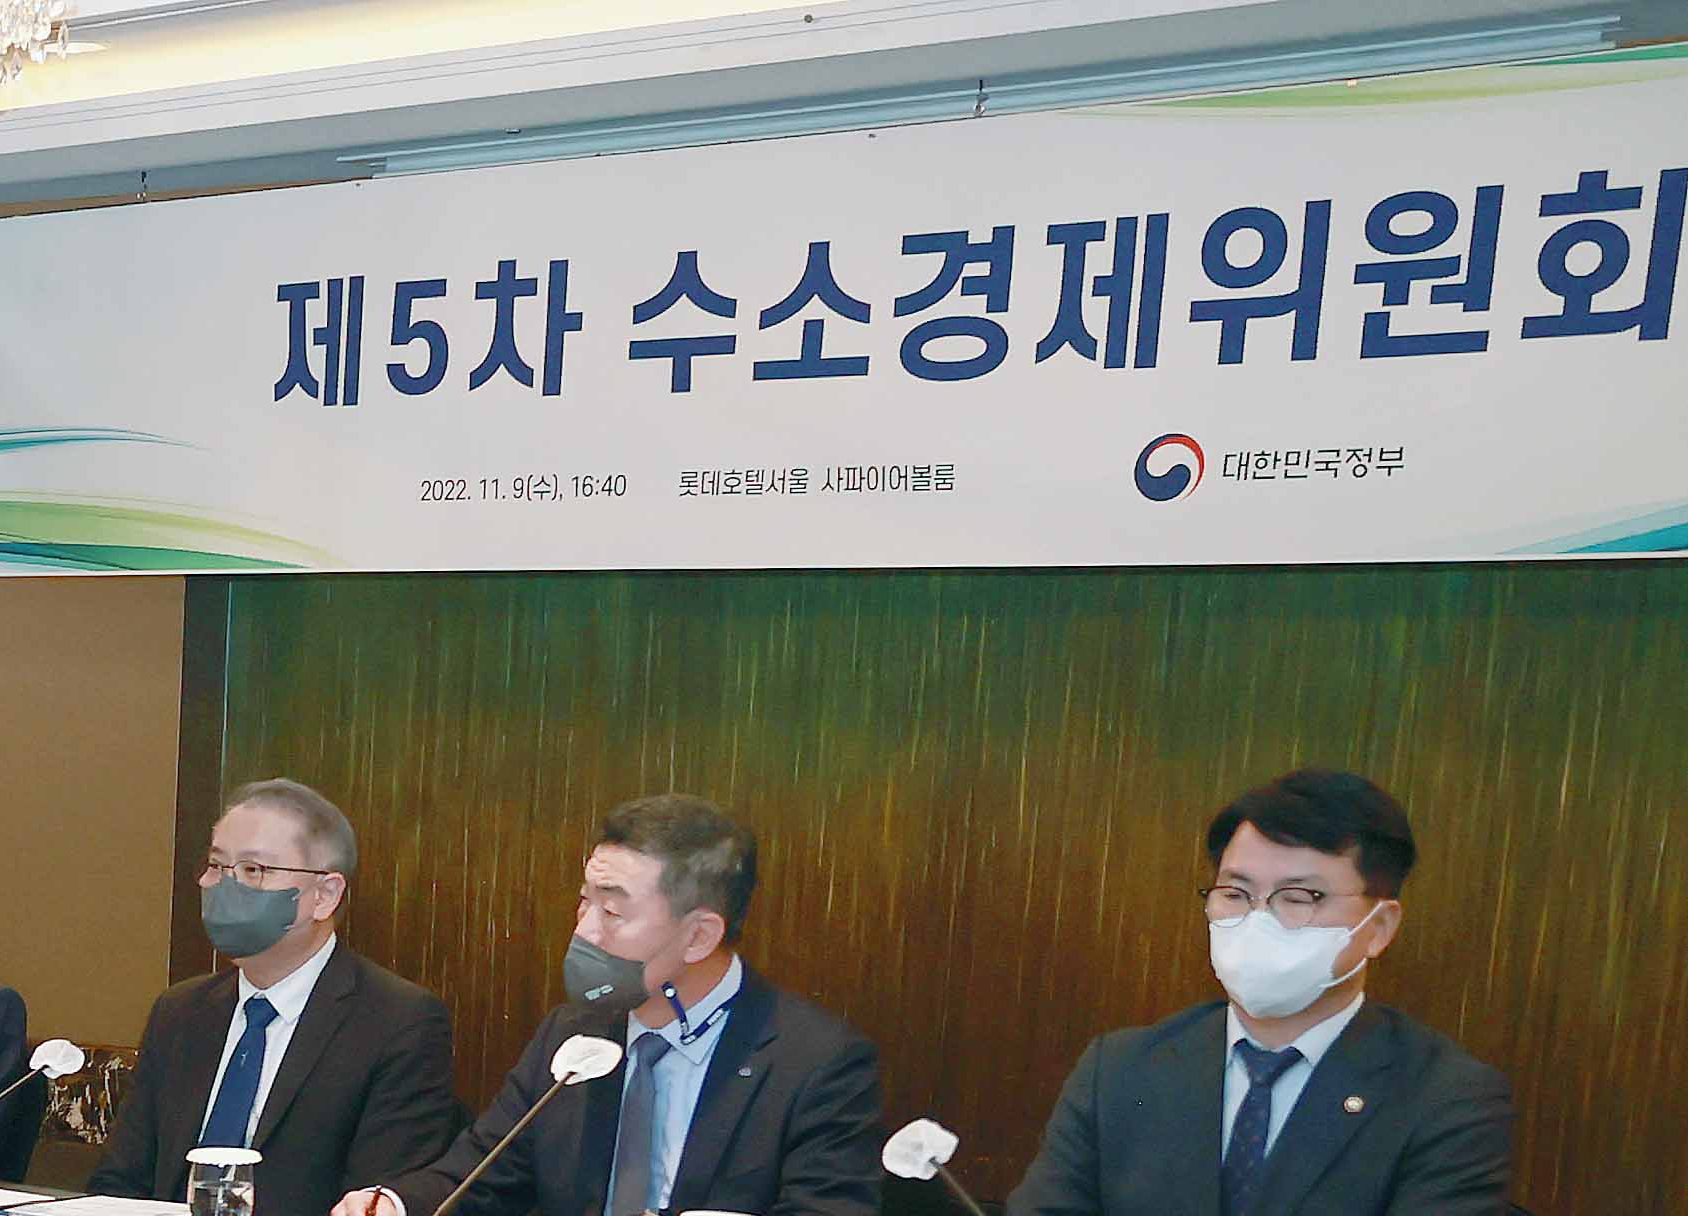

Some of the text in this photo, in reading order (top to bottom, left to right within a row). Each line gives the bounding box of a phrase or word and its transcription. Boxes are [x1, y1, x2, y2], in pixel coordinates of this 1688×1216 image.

[274, 168, 1688, 406] 제5차 수소경제위원회
[420, 478, 472, 502] 2022.
[572, 473, 628, 499] 16:40
[677, 467, 810, 499] 롯데호텔서울
[821, 463, 956, 496] 사파이어볼룸
[1221, 445, 1406, 484] 대한민국정부
